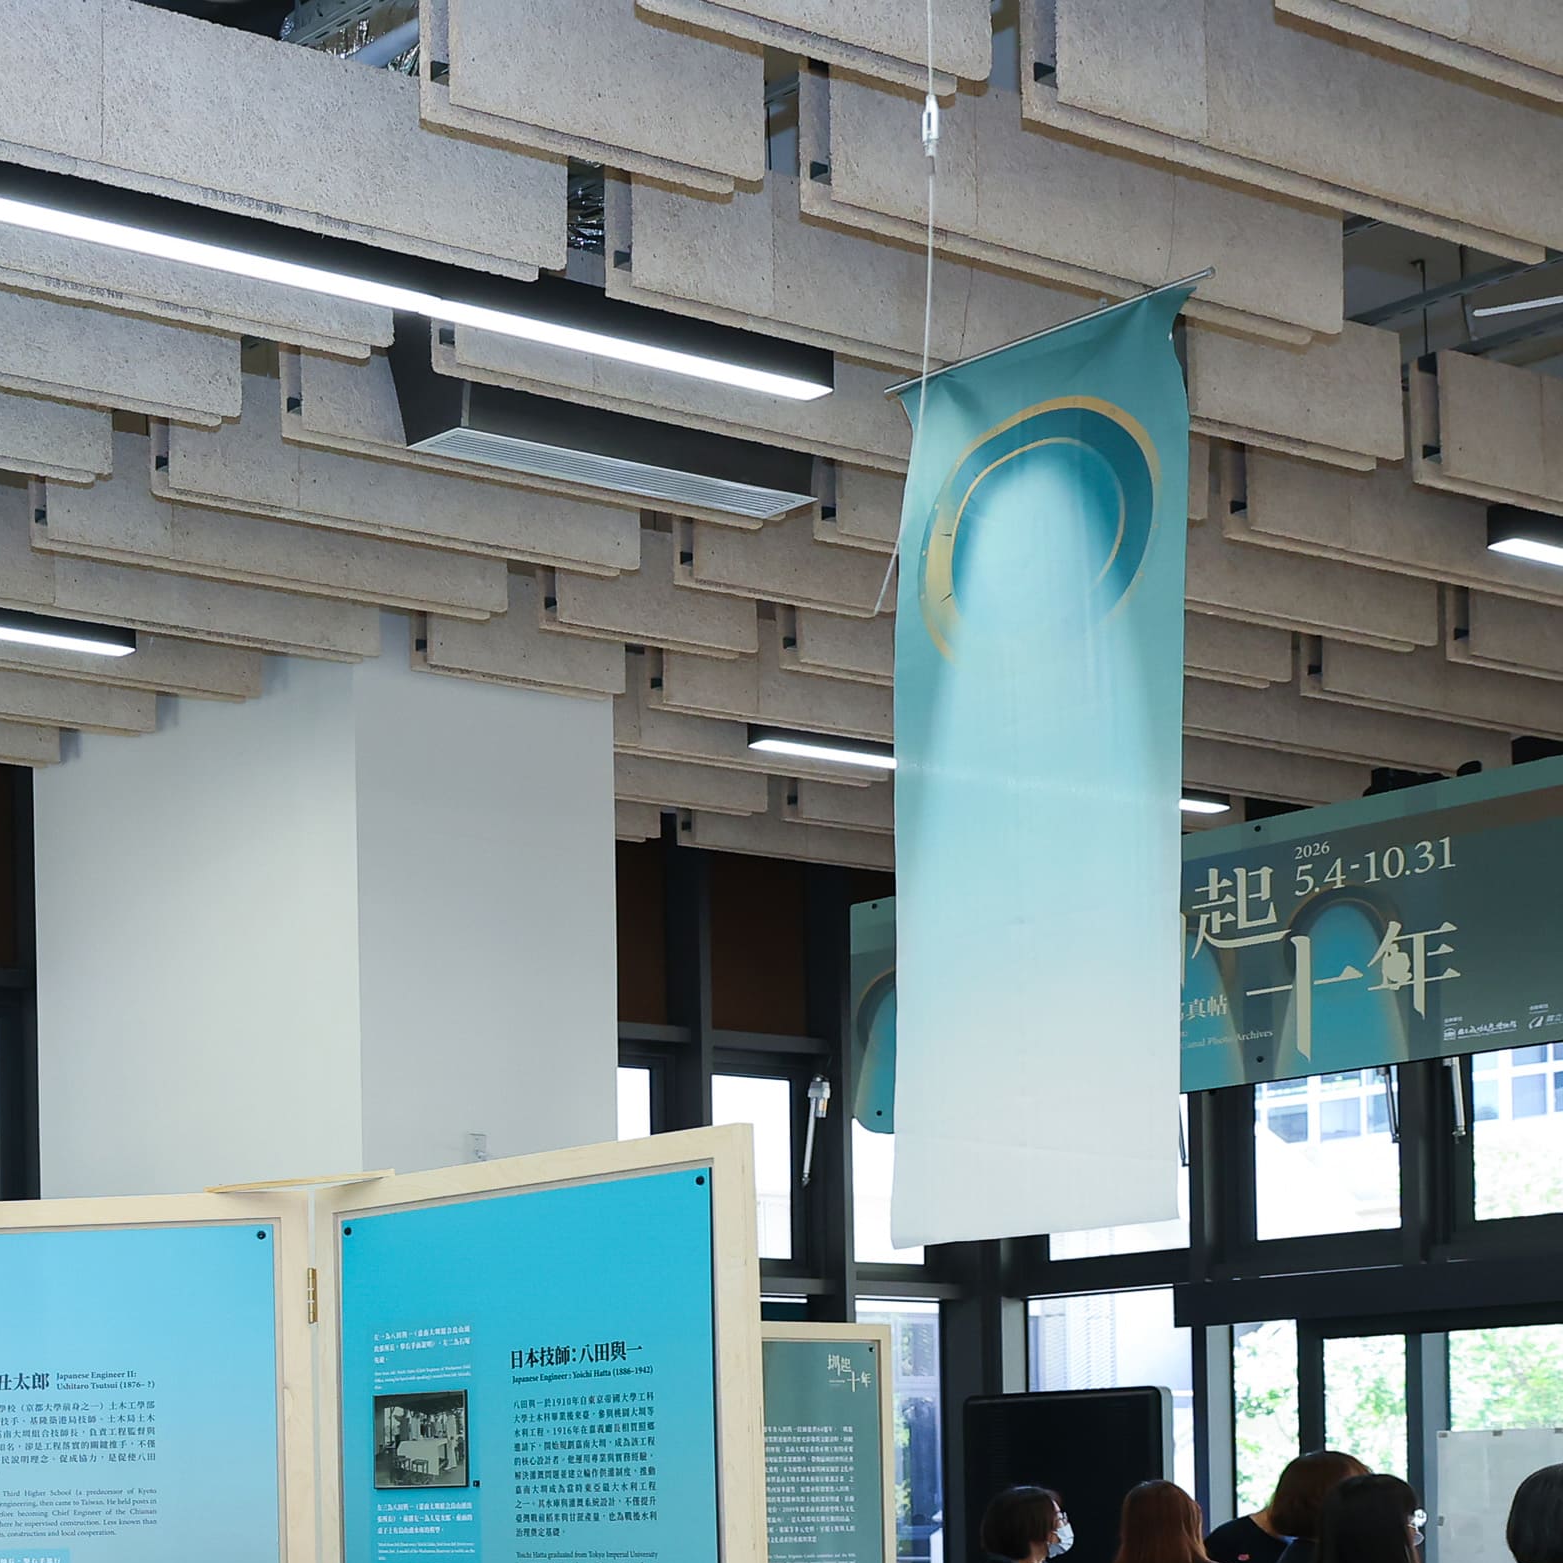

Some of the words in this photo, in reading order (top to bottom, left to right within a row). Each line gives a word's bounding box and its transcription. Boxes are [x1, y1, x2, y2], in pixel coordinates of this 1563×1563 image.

[1295, 841, 1330, 859] 2026
[1294, 836, 1457, 897] 5.4-10.31
[1181, 866, 1292, 970] 起
[56, 1372, 89, 1381] Japanese
[91, 1371, 125, 1380] Engineer
[512, 1375, 539, 1384] Japanese
[540, 1373, 568, 1383] Engineer
[572, 1370, 593, 1380] Yoichi
[594, 1369, 612, 1378] Hatta
[56, 1382, 89, 1390] Ushitaro
[91, 1381, 118, 1389] Tsutsui
